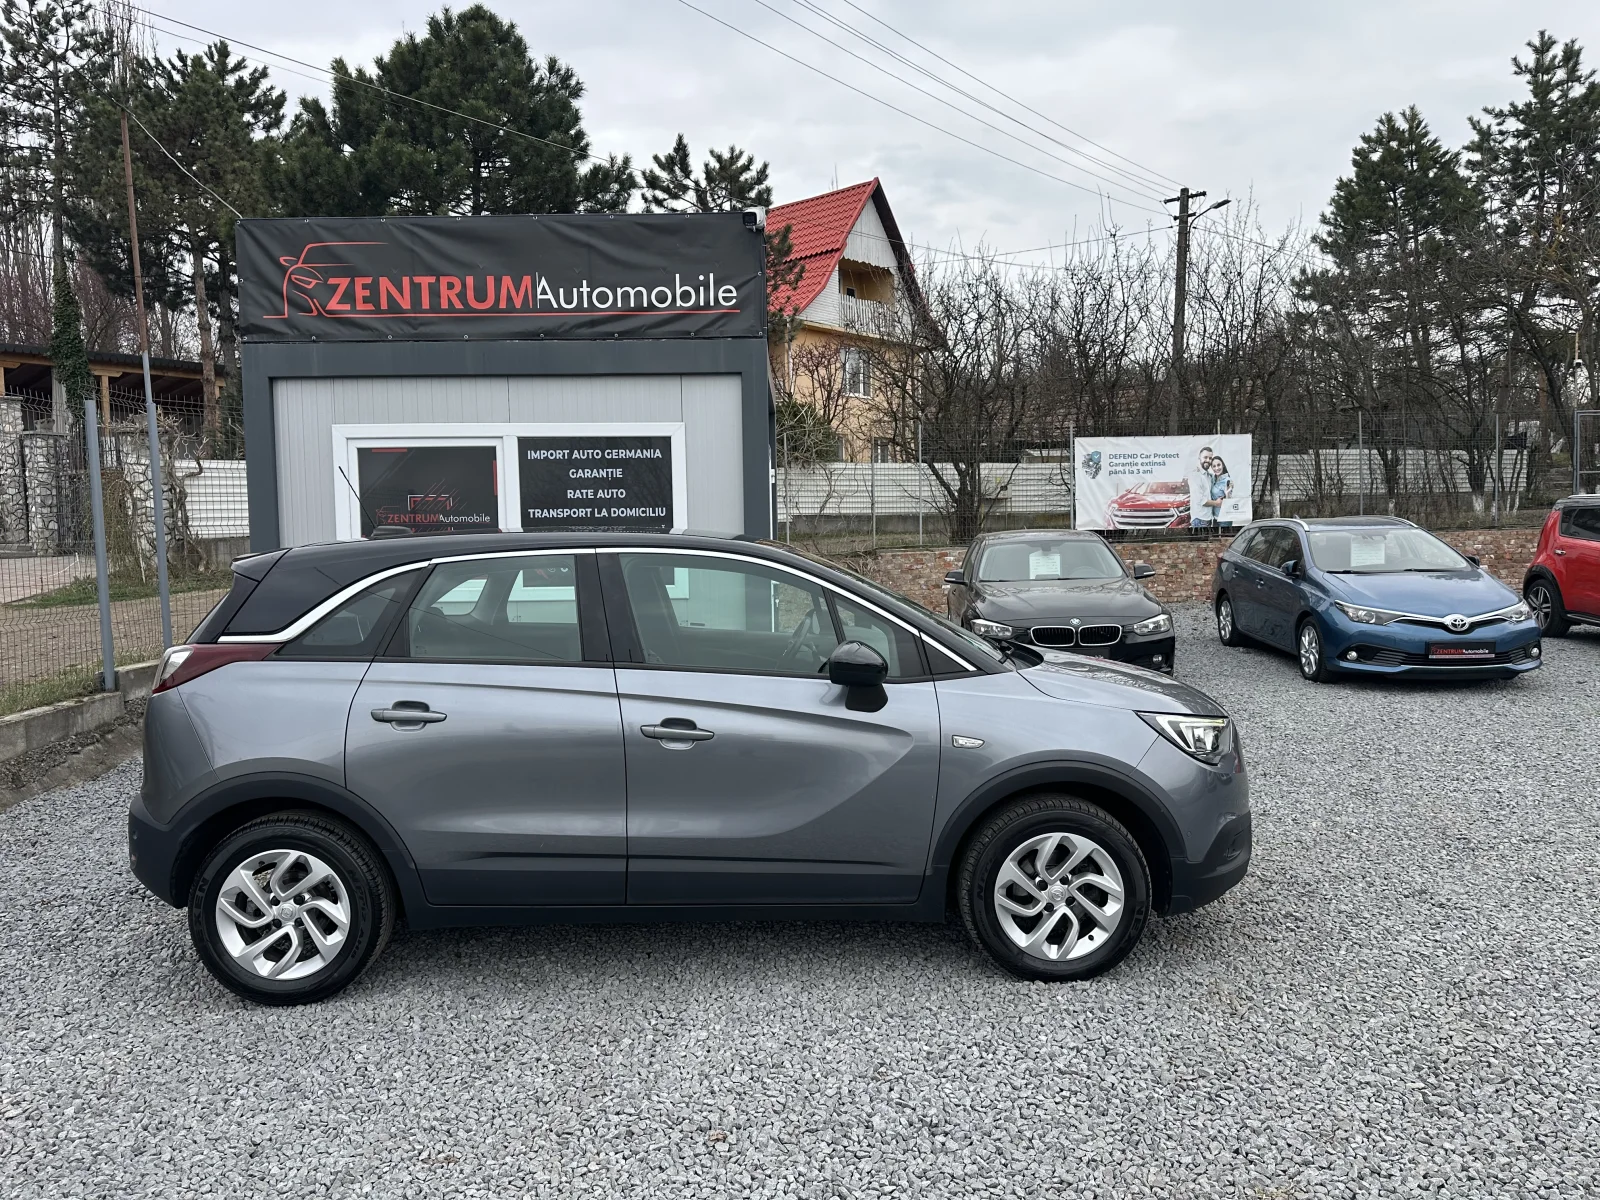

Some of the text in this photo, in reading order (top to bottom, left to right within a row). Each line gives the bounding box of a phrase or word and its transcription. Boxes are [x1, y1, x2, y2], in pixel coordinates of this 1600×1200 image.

[327, 272, 738, 310] ZENTRUM Automobile
[527, 448, 662, 460] IMPORT AUTO GERMANIA
[1139, 452, 1152, 460] Car
[568, 468, 623, 481] GARANȚIE
[1142, 467, 1153, 475] ani
[566, 489, 627, 499] RATE AUTO
[387, 512, 491, 523] ZENTRUM Automobile
[527, 507, 666, 519] TRANSPORT LA DOMICILIU
